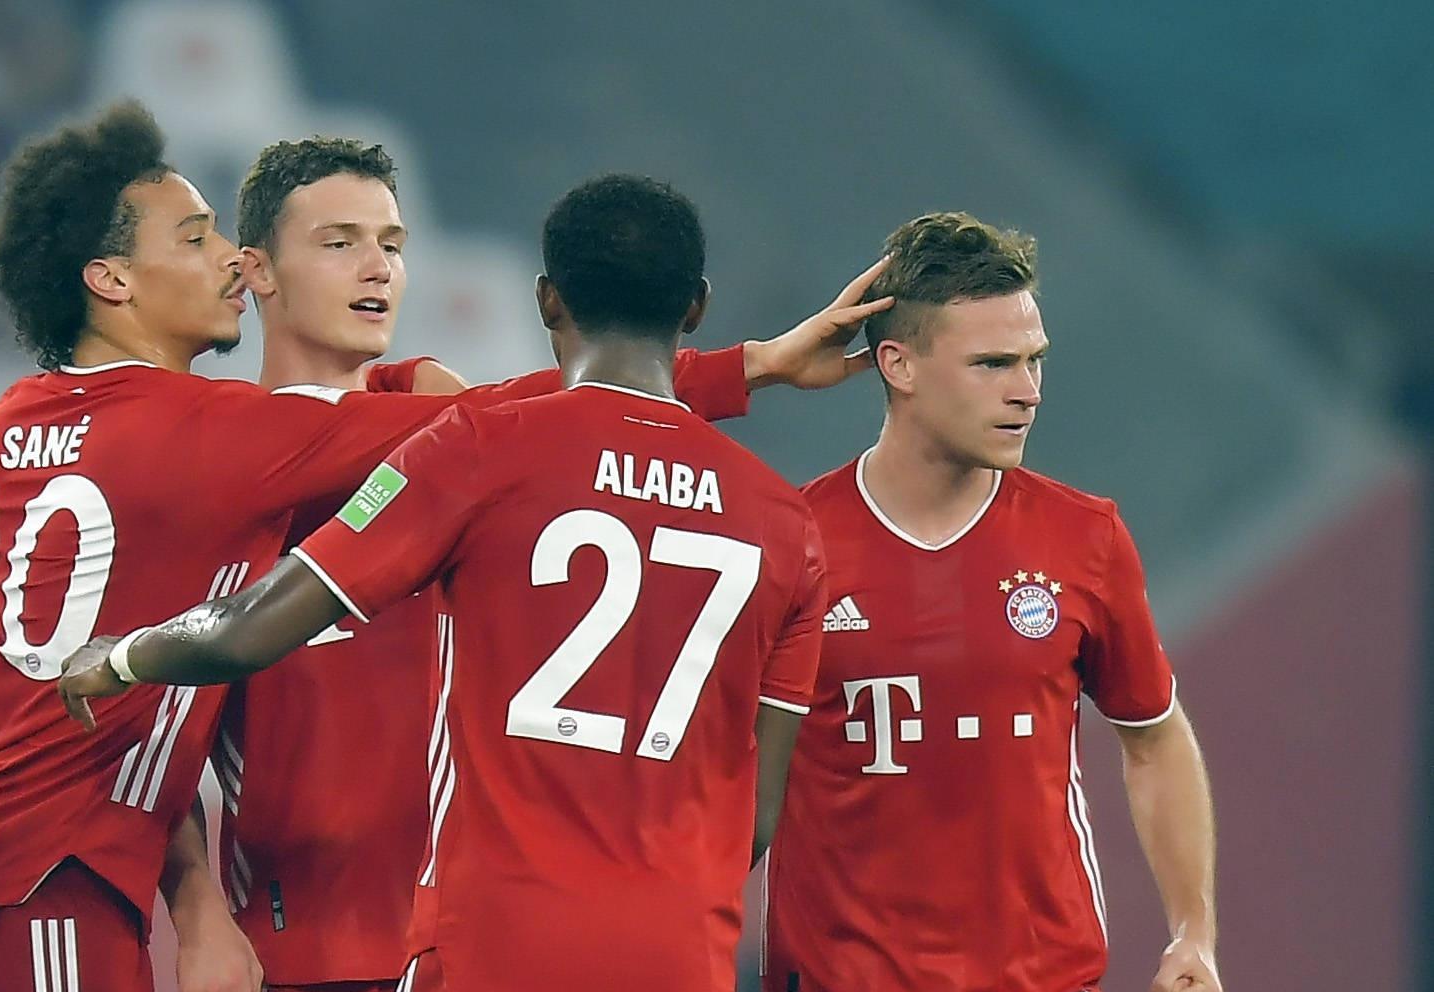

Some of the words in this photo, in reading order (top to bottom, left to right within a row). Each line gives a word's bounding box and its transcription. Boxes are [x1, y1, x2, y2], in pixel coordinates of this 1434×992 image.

[0, 414, 92, 469] SANÉ
[593, 449, 724, 513] ALABA
[506, 508, 763, 762] 27
